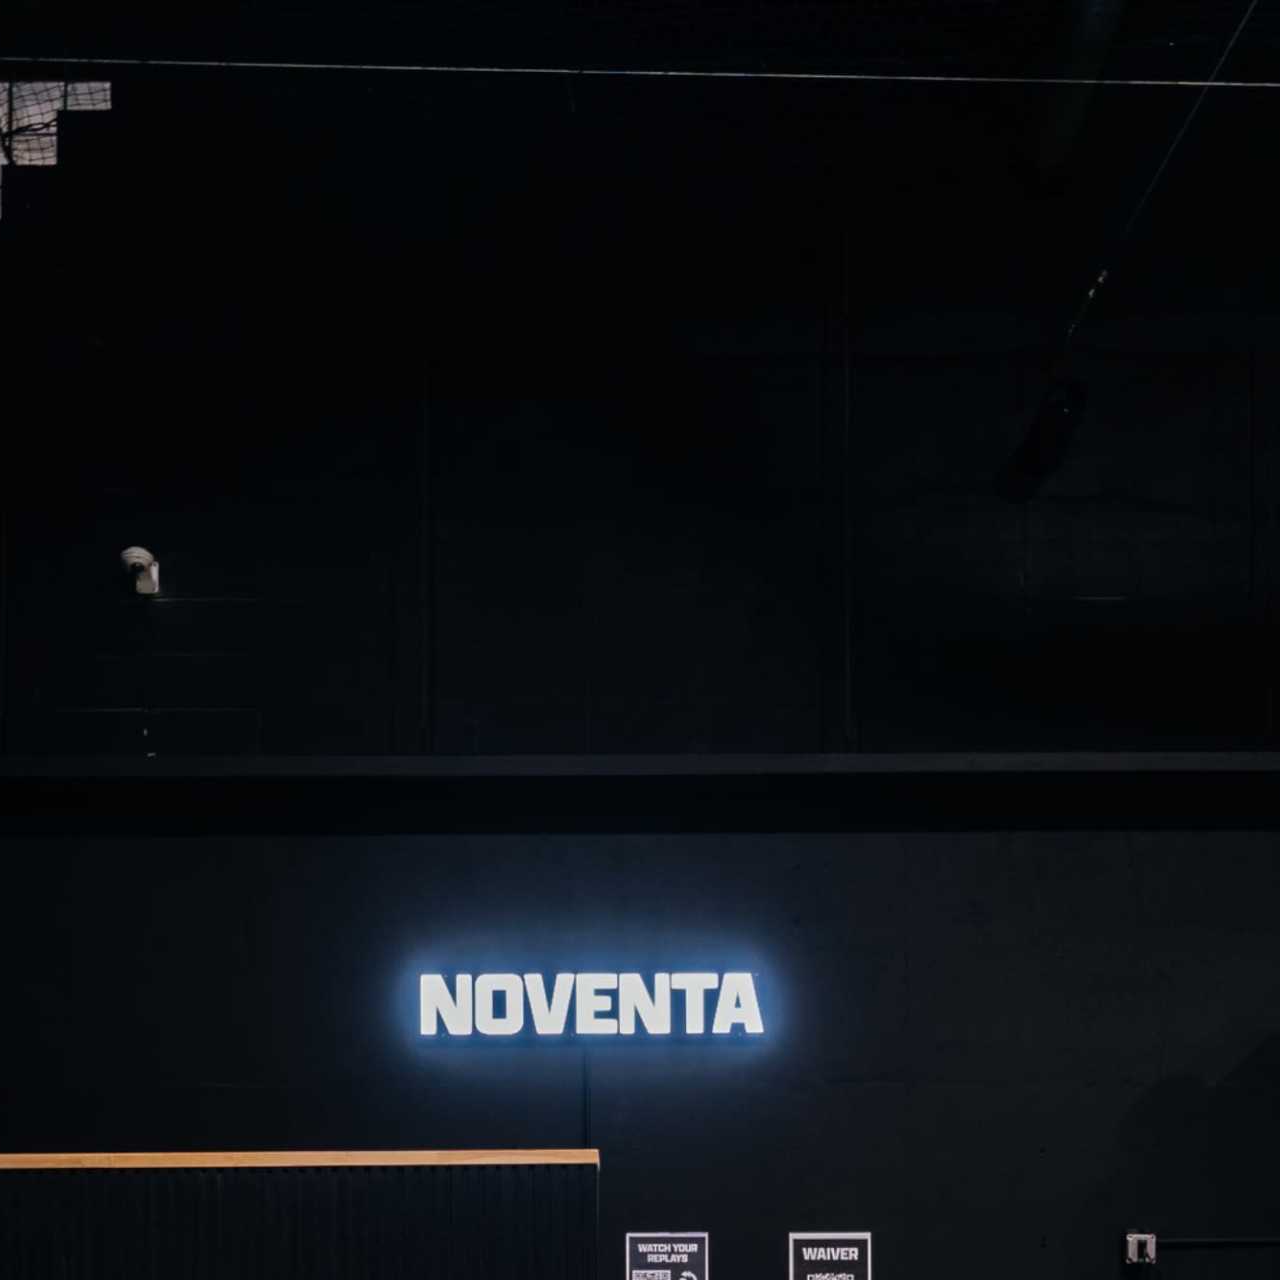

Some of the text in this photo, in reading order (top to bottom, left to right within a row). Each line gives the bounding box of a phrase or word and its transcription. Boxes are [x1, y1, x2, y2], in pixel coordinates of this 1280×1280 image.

[419, 971, 765, 1036] NOVENTA
[638, 1243, 698, 1253] WATCH YOUR
[802, 1247, 859, 1261] WAIVER
[647, 1254, 689, 1263] REPLAYS
